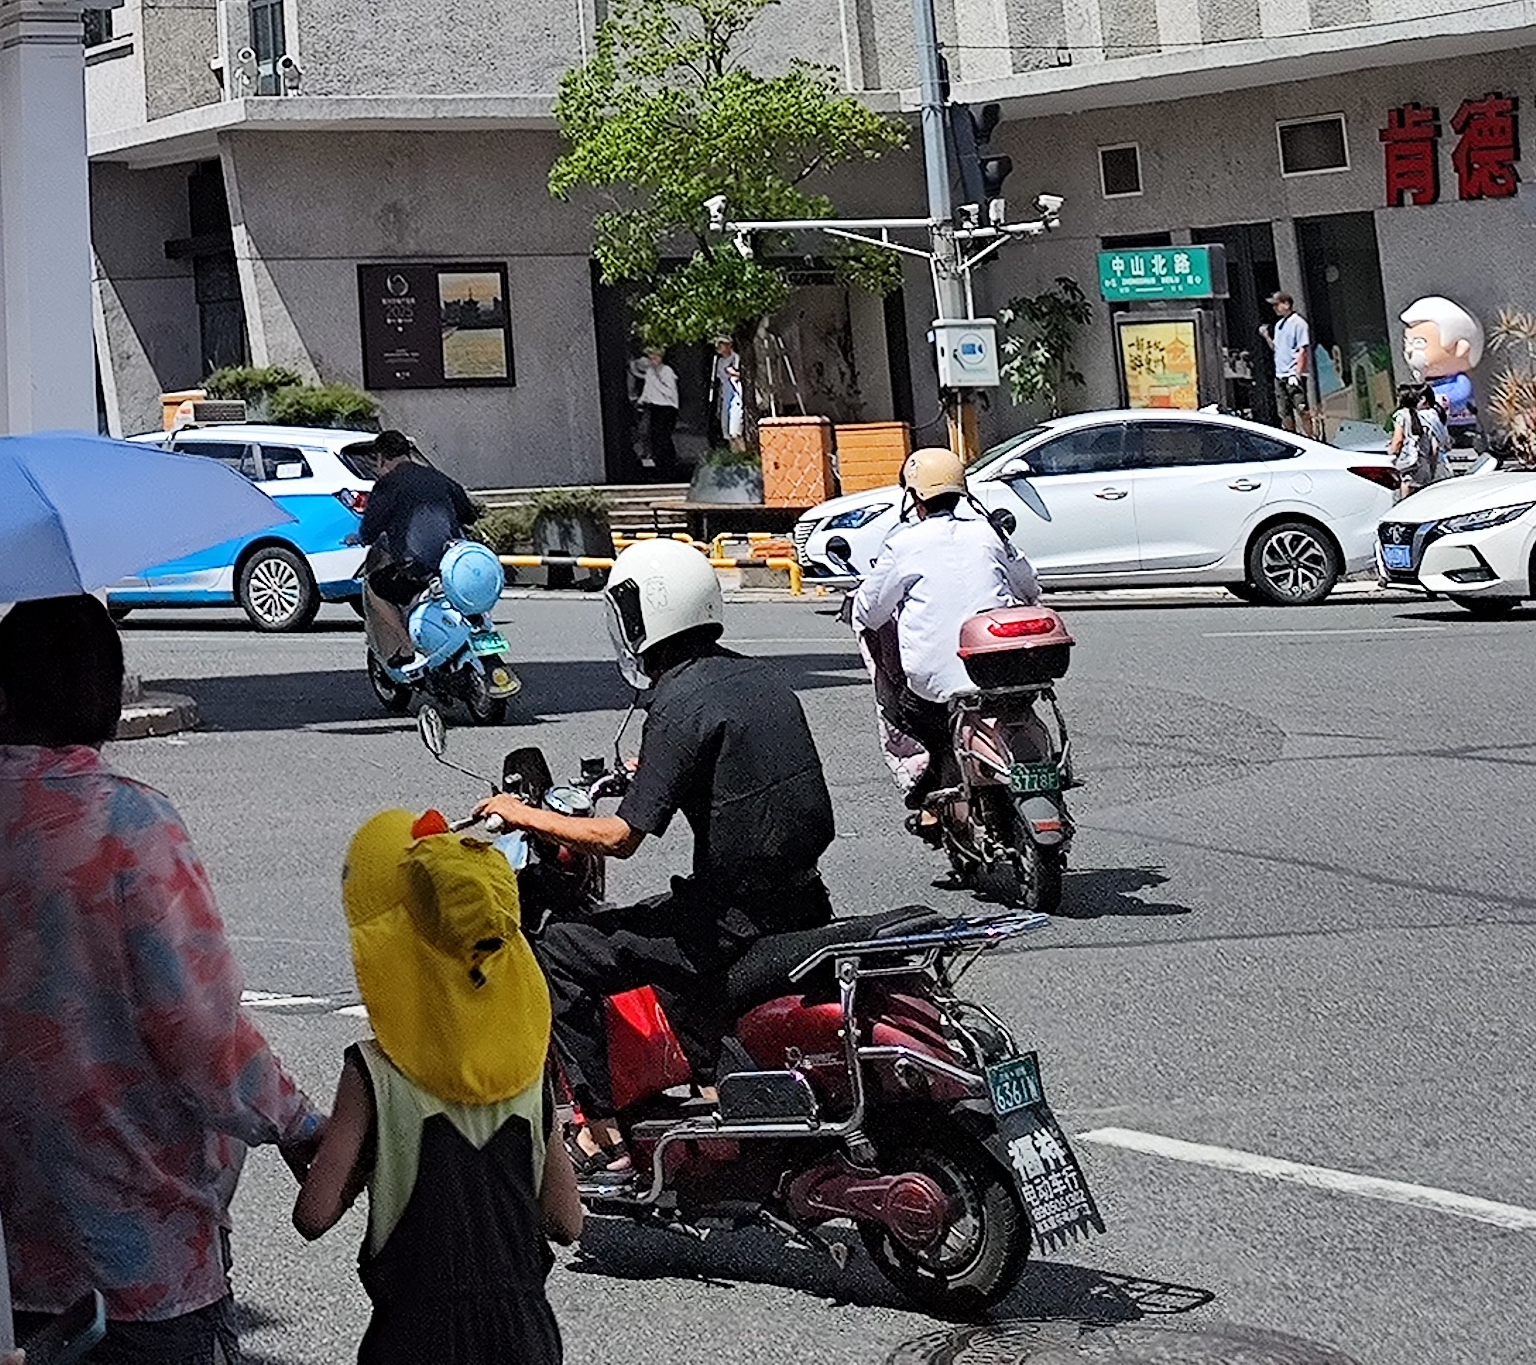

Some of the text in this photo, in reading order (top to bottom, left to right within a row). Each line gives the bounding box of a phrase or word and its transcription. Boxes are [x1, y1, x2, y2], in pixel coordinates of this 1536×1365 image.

[1378, 92, 1536, 208] 肯德
[1111, 253, 1191, 277] 中山北路
[1022, 1164, 1080, 1206] 电动车行
